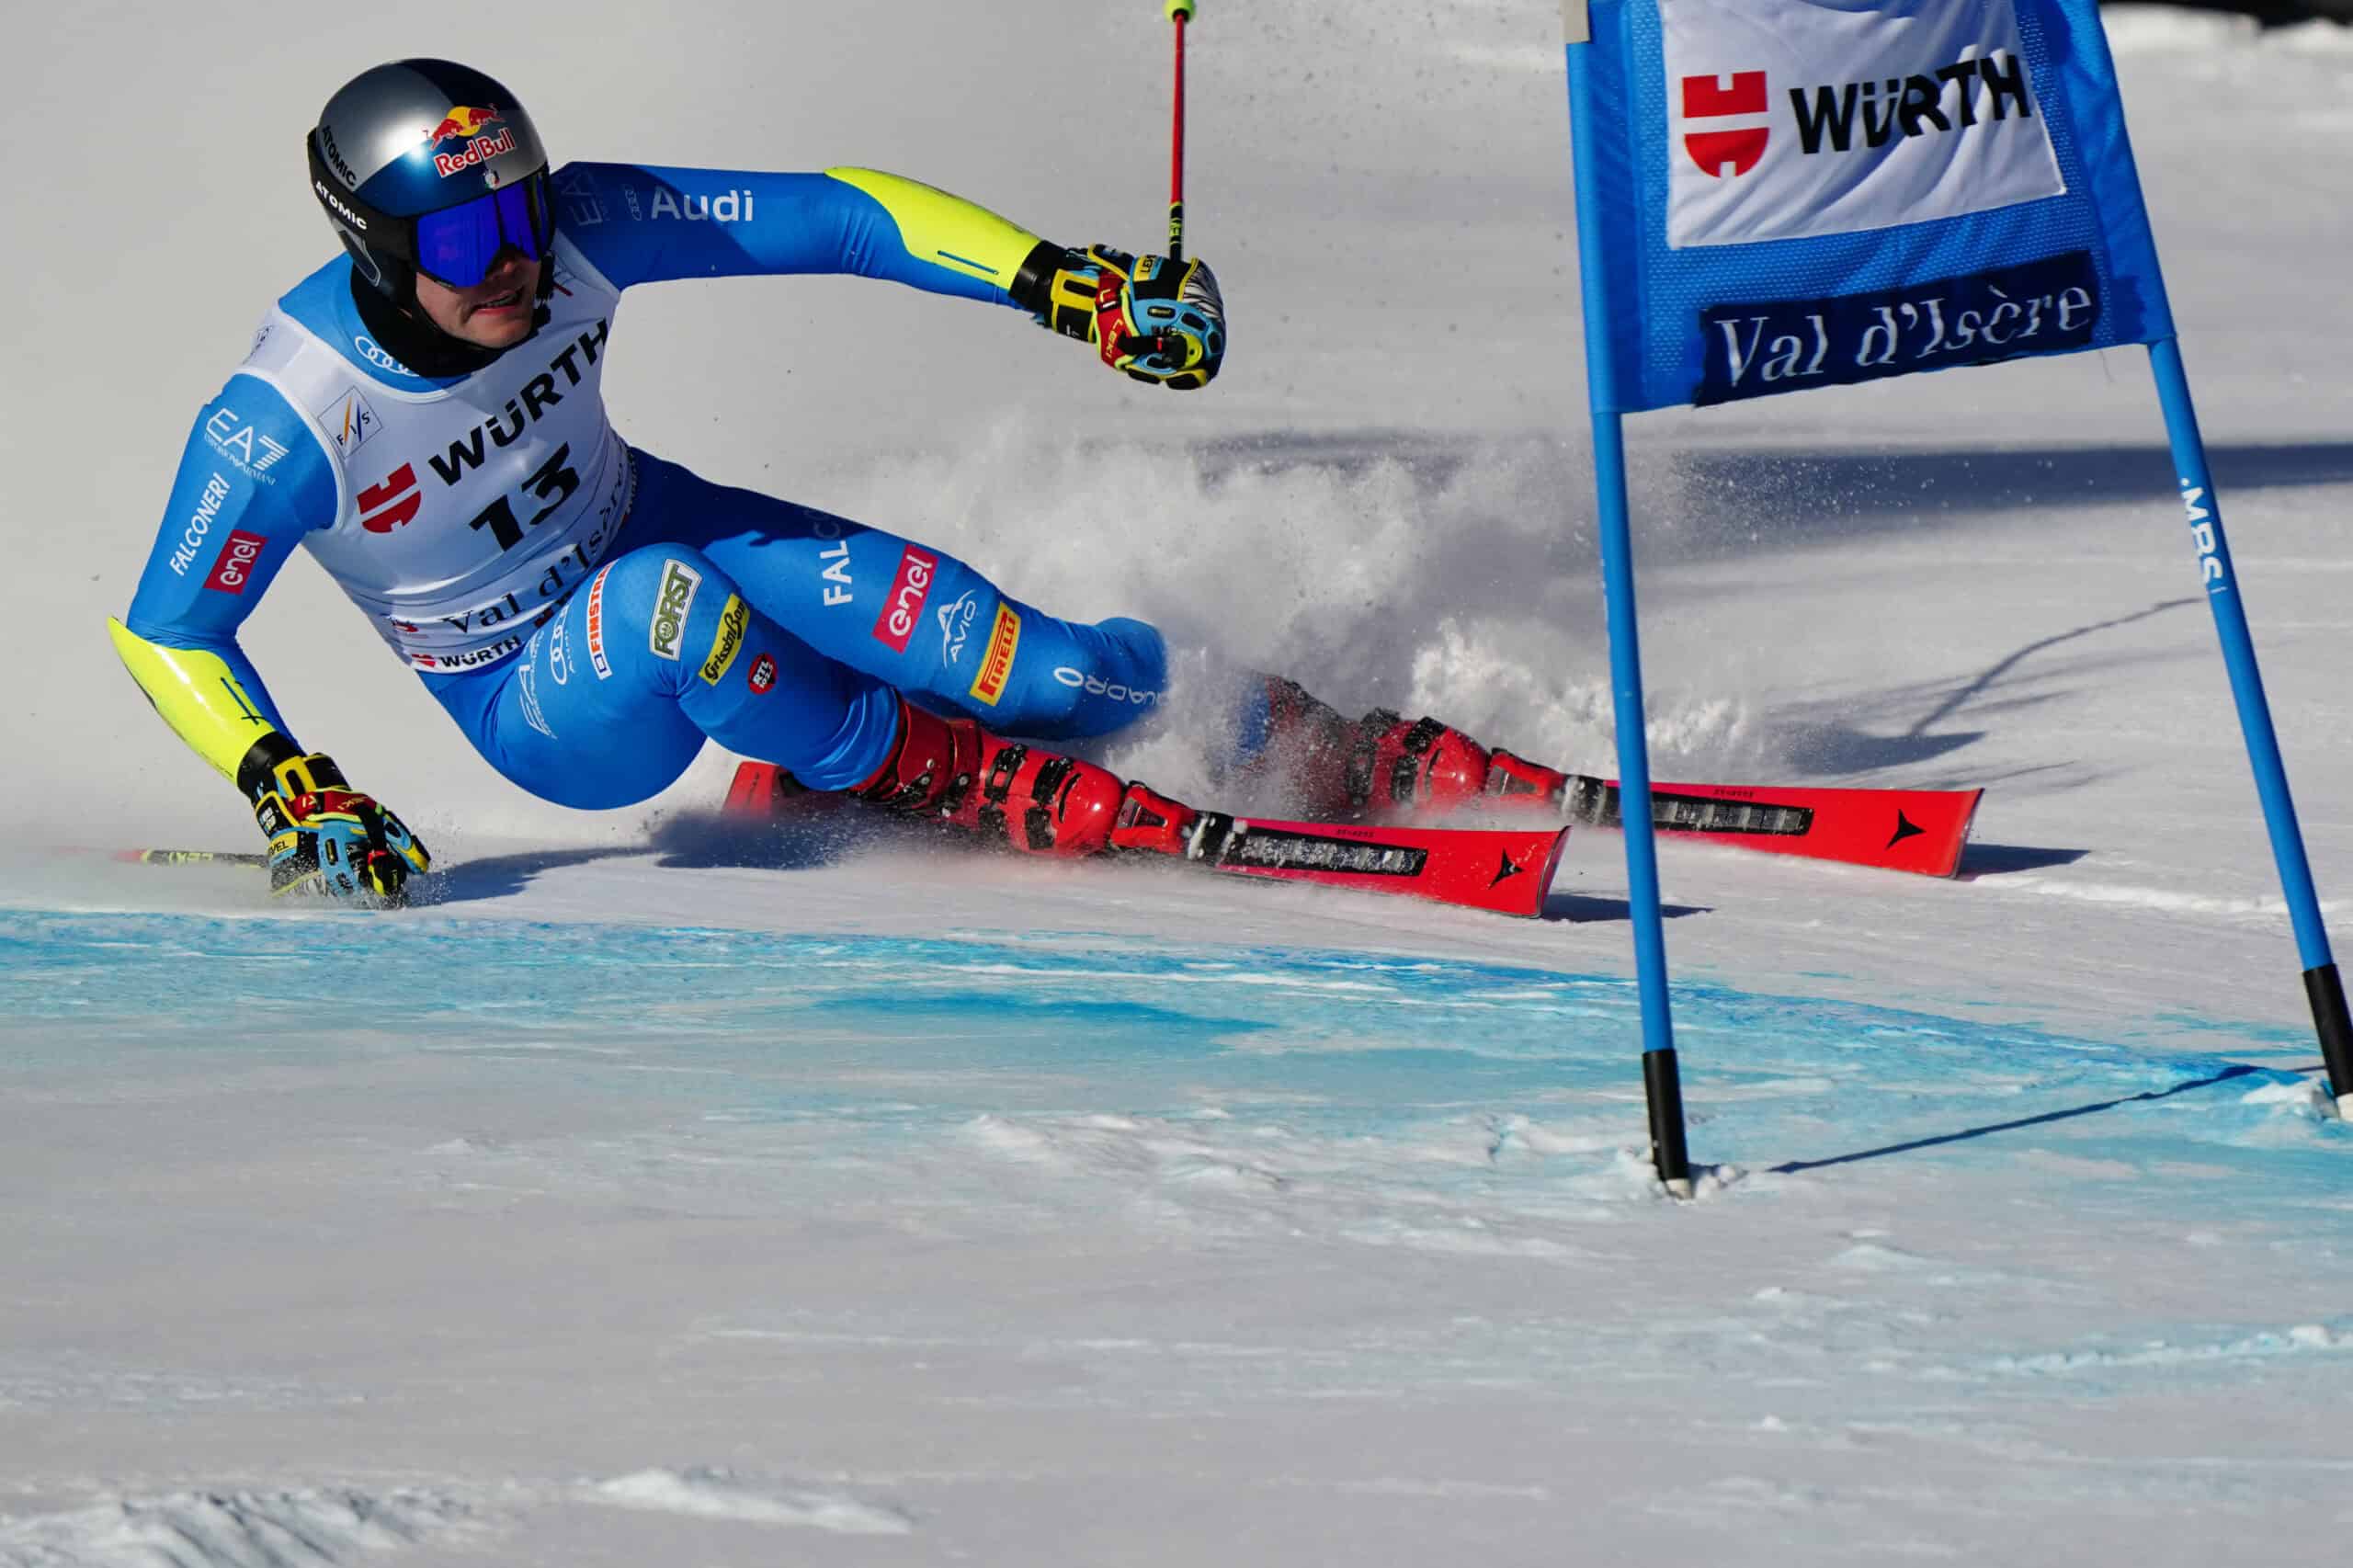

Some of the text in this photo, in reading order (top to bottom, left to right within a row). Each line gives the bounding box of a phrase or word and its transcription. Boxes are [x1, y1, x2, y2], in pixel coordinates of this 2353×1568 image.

[1788, 54, 2031, 155] WÜRTH
[322, 126, 358, 186] ATOMIC
[435, 128, 516, 177] Red Bull
[315, 181, 368, 230] ATOMIC
[651, 186, 755, 222] Audi
[1714, 284, 2093, 388] Val d'Isère
[428, 318, 608, 486] WÜRTH
[170, 472, 231, 576] FALCONERI
[469, 441, 581, 552] 13
[221, 538, 262, 585] enel
[889, 553, 933, 636] enel
[441, 593, 525, 634] Val
[654, 563, 696, 656] FORST
[950, 600, 977, 663] AVIO
[438, 635, 522, 668] WÜRTH
[978, 610, 1017, 698] PIRELLI
